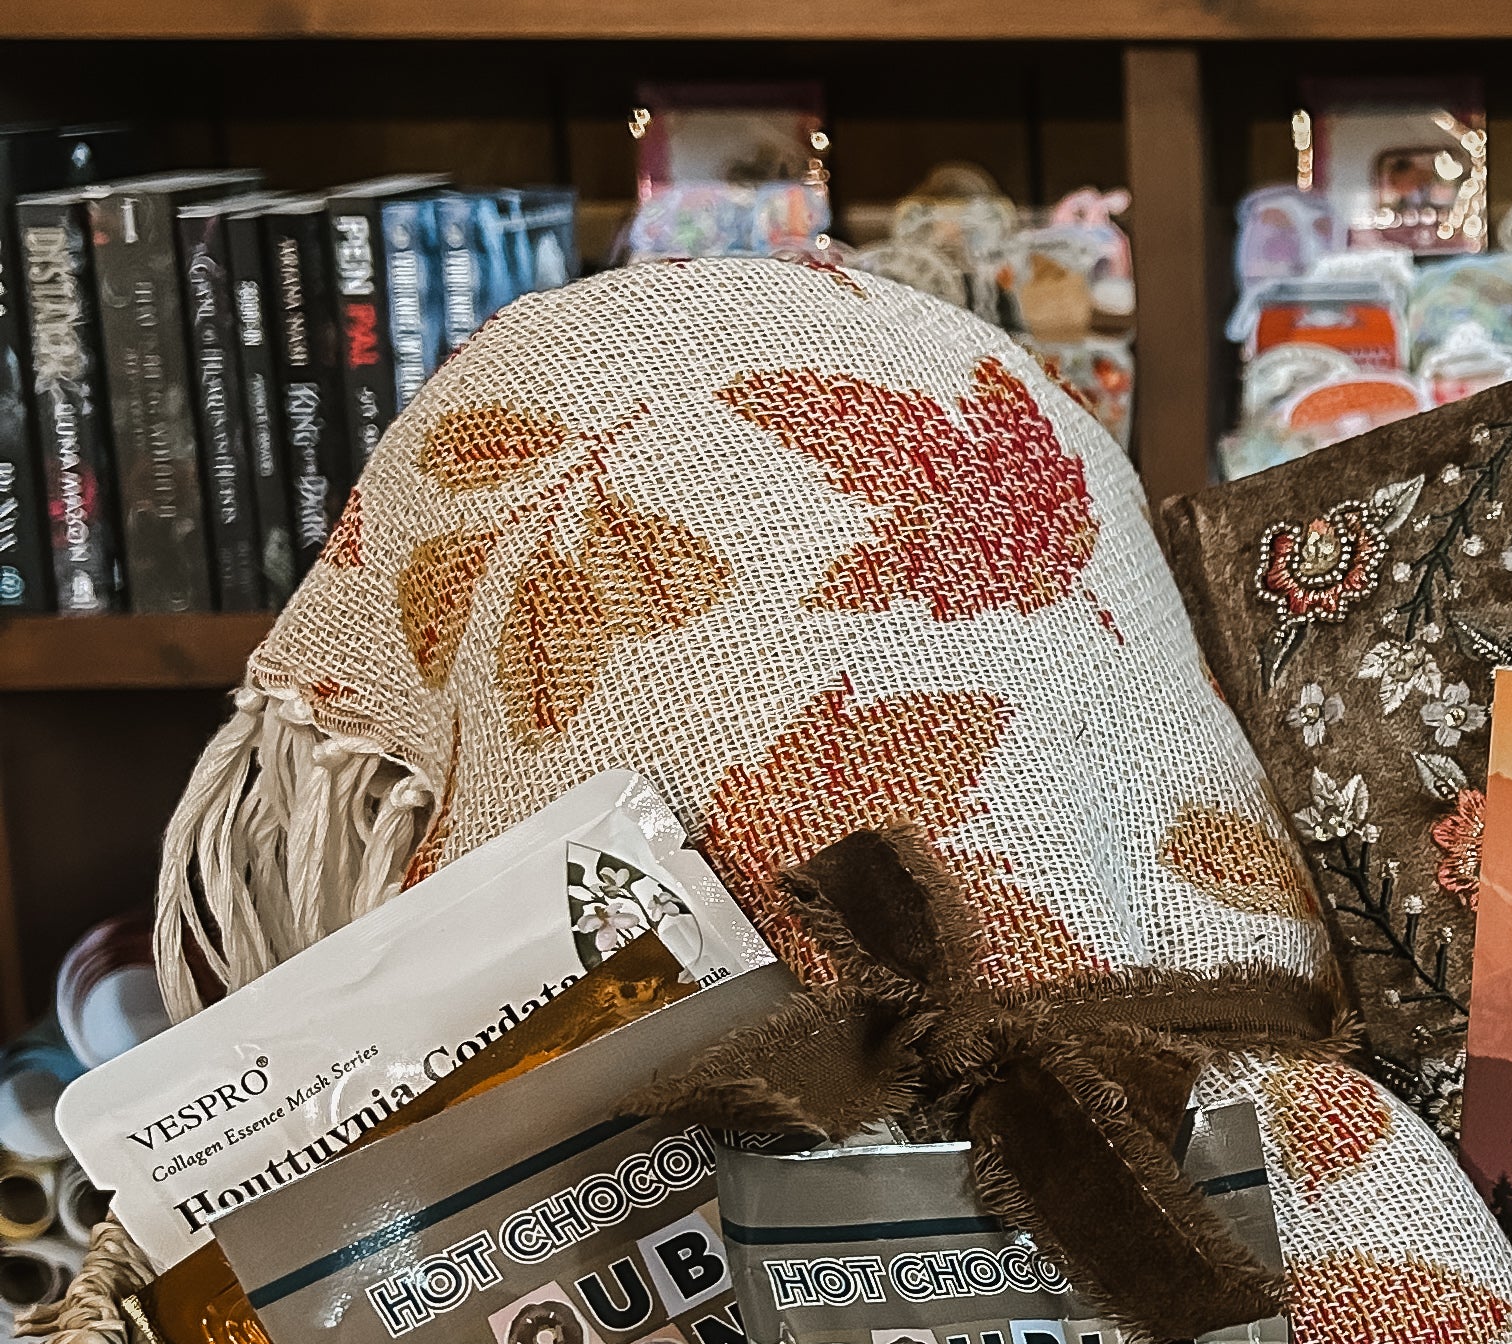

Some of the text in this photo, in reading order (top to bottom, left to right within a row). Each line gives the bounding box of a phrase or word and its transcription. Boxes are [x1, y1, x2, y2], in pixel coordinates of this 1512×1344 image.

[334, 216, 379, 367] PEN PAL
[54, 403, 88, 562] LUNA MASON
[152, 1044, 379, 1182] Collagen Essence Mask Series
[366, 1125, 730, 1337] HOT CHOCOL
[763, 1243, 1074, 1311] HOT CHOCO
